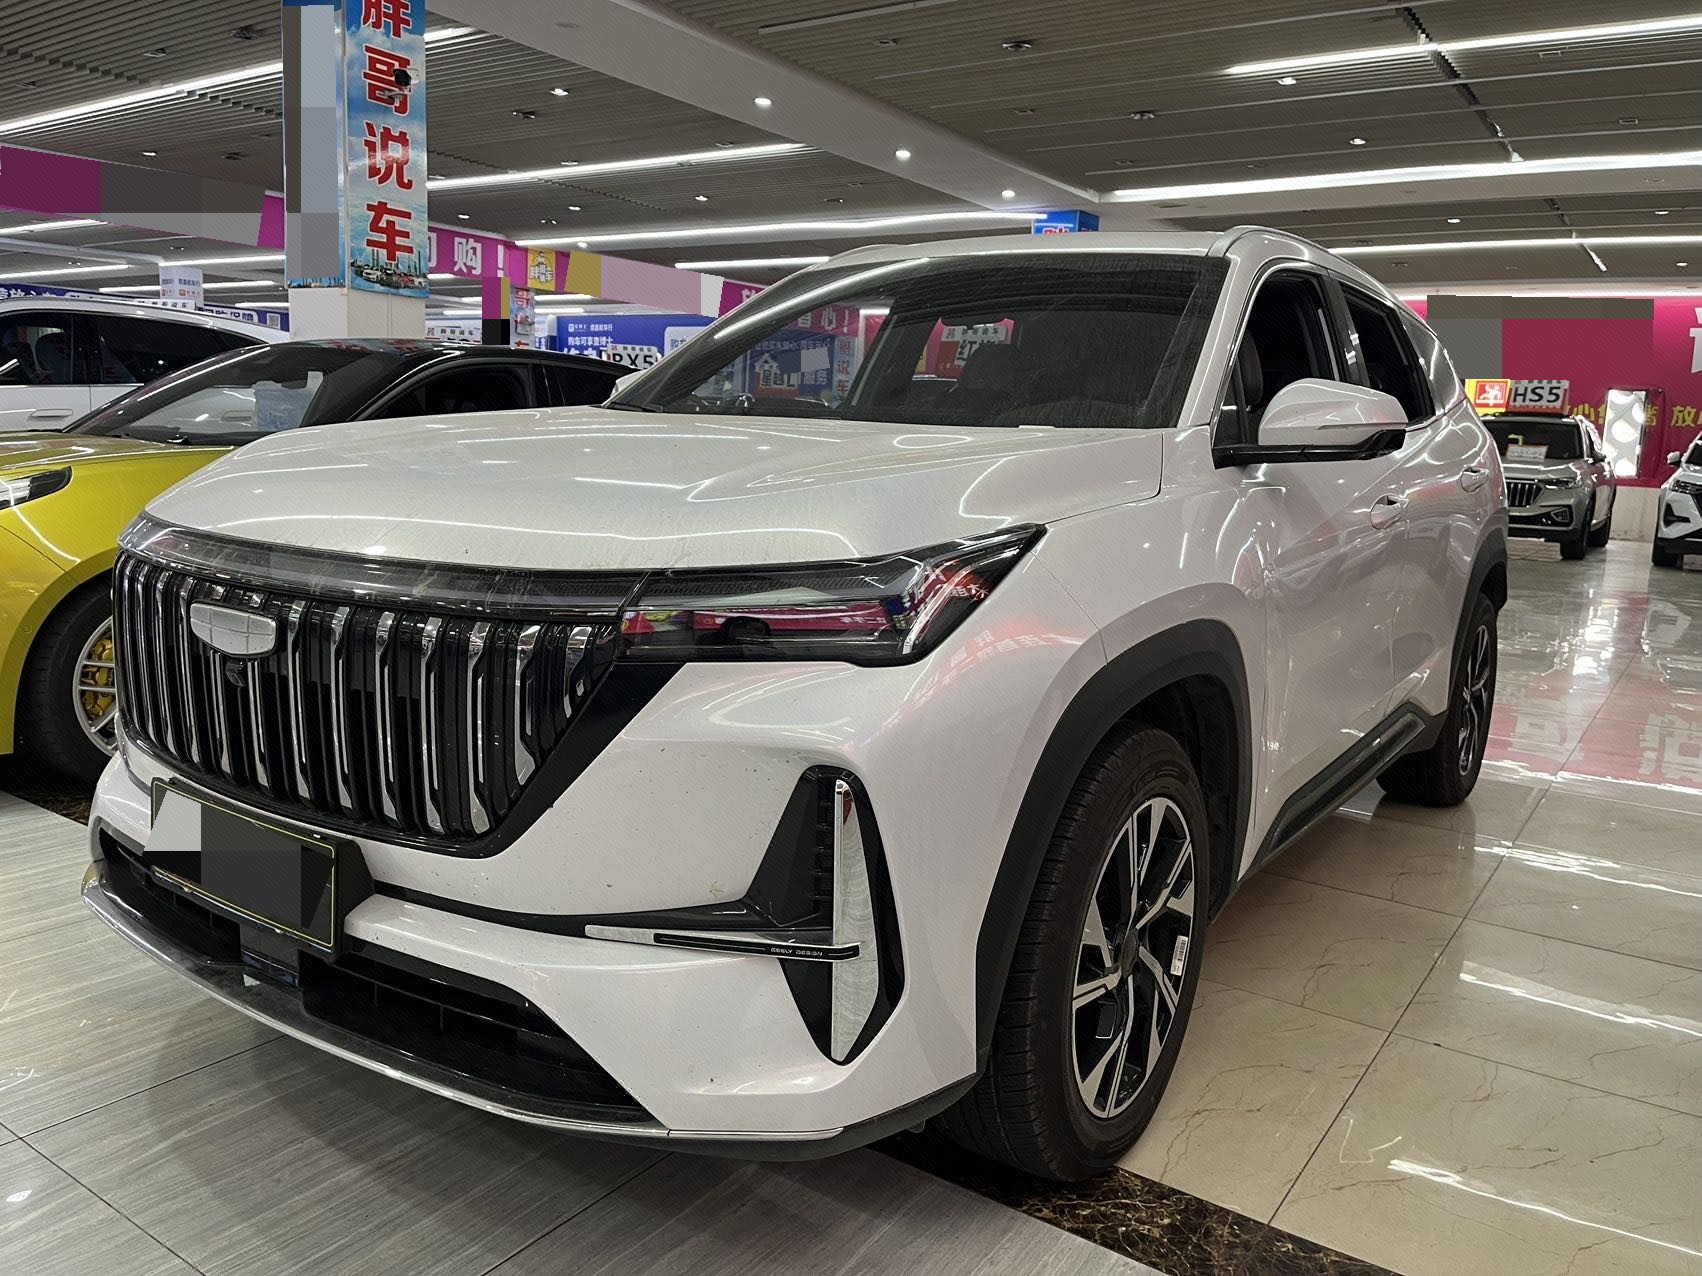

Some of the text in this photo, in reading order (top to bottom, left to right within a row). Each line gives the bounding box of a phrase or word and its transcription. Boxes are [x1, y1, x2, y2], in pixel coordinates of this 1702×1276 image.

[361, 0, 414, 263] 胖哥说车
[761, 369, 796, 388] 星越L
[1512, 386, 1561, 403] HS5
[796, 949, 823, 957] DESIGN
